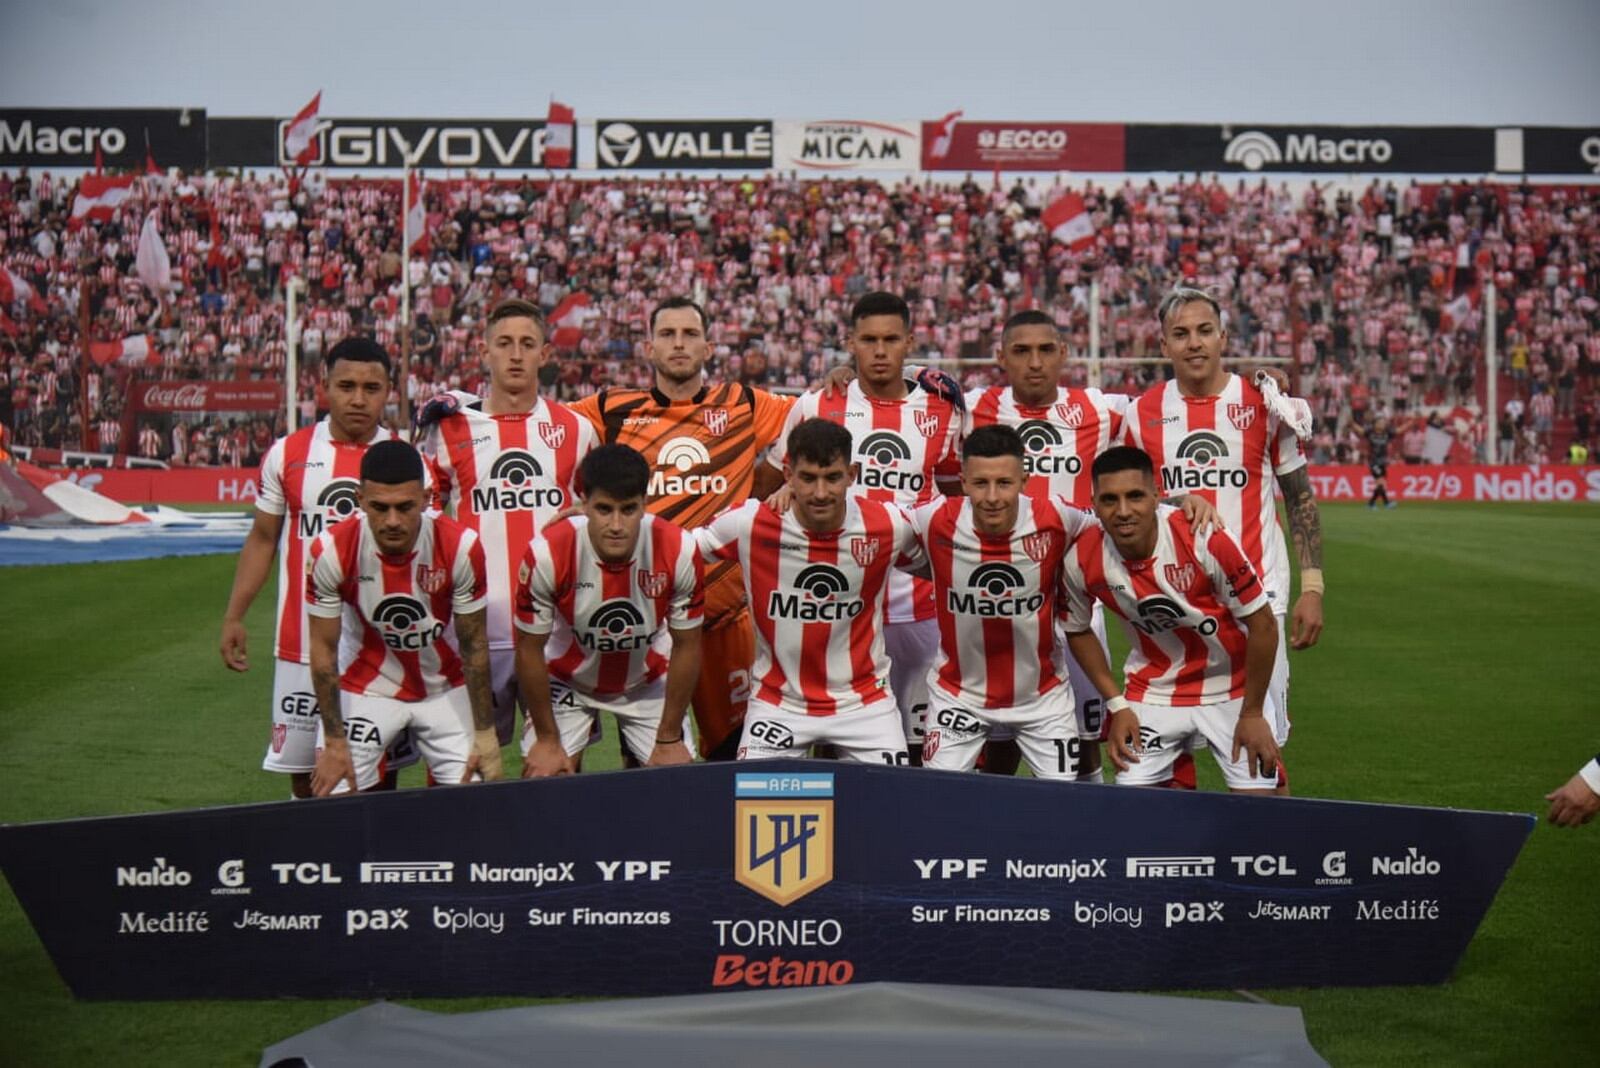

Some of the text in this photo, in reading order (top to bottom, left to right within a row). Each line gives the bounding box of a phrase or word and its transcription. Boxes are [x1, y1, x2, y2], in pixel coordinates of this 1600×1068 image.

[0, 120, 126, 154] Macro
[646, 126, 772, 158] VALLÉ
[800, 136, 901, 160] MICAM
[997, 129, 1067, 148] ECCO
[1285, 134, 1393, 163] Macro
[1023, 456, 1082, 475] acro
[1162, 465, 1248, 490] Macro
[1402, 472, 1462, 499] 22/9
[1474, 464, 1577, 501] Naldo
[473, 487, 563, 513] Macro
[769, 592, 864, 621] Macro
[949, 590, 1044, 617] Macro
[383, 622, 445, 650] acro
[937, 709, 981, 733] GEA
[750, 720, 794, 750] GEA
[769, 778, 801, 791] AFA
[116, 857, 192, 886] Naldo
[271, 862, 342, 884] TCL
[360, 861, 454, 883] PIRELLI
[595, 860, 672, 881] YPF
[913, 858, 988, 879] YPF
[1126, 856, 1216, 878] PIRELLI
[1231, 855, 1297, 876] TCL
[1372, 848, 1441, 875] Naldo
[118, 911, 209, 933] Medifé
[346, 907, 410, 936] pax
[433, 906, 505, 934] bplay
[528, 907, 671, 926] Sur Finanzas
[911, 904, 1051, 923] Sur Finanzas
[1074, 900, 1143, 929] bplay
[1165, 900, 1224, 929] pax
[1355, 900, 1440, 921] Medifé
[712, 919, 842, 947] TORNEO
[712, 954, 855, 988] Betano
